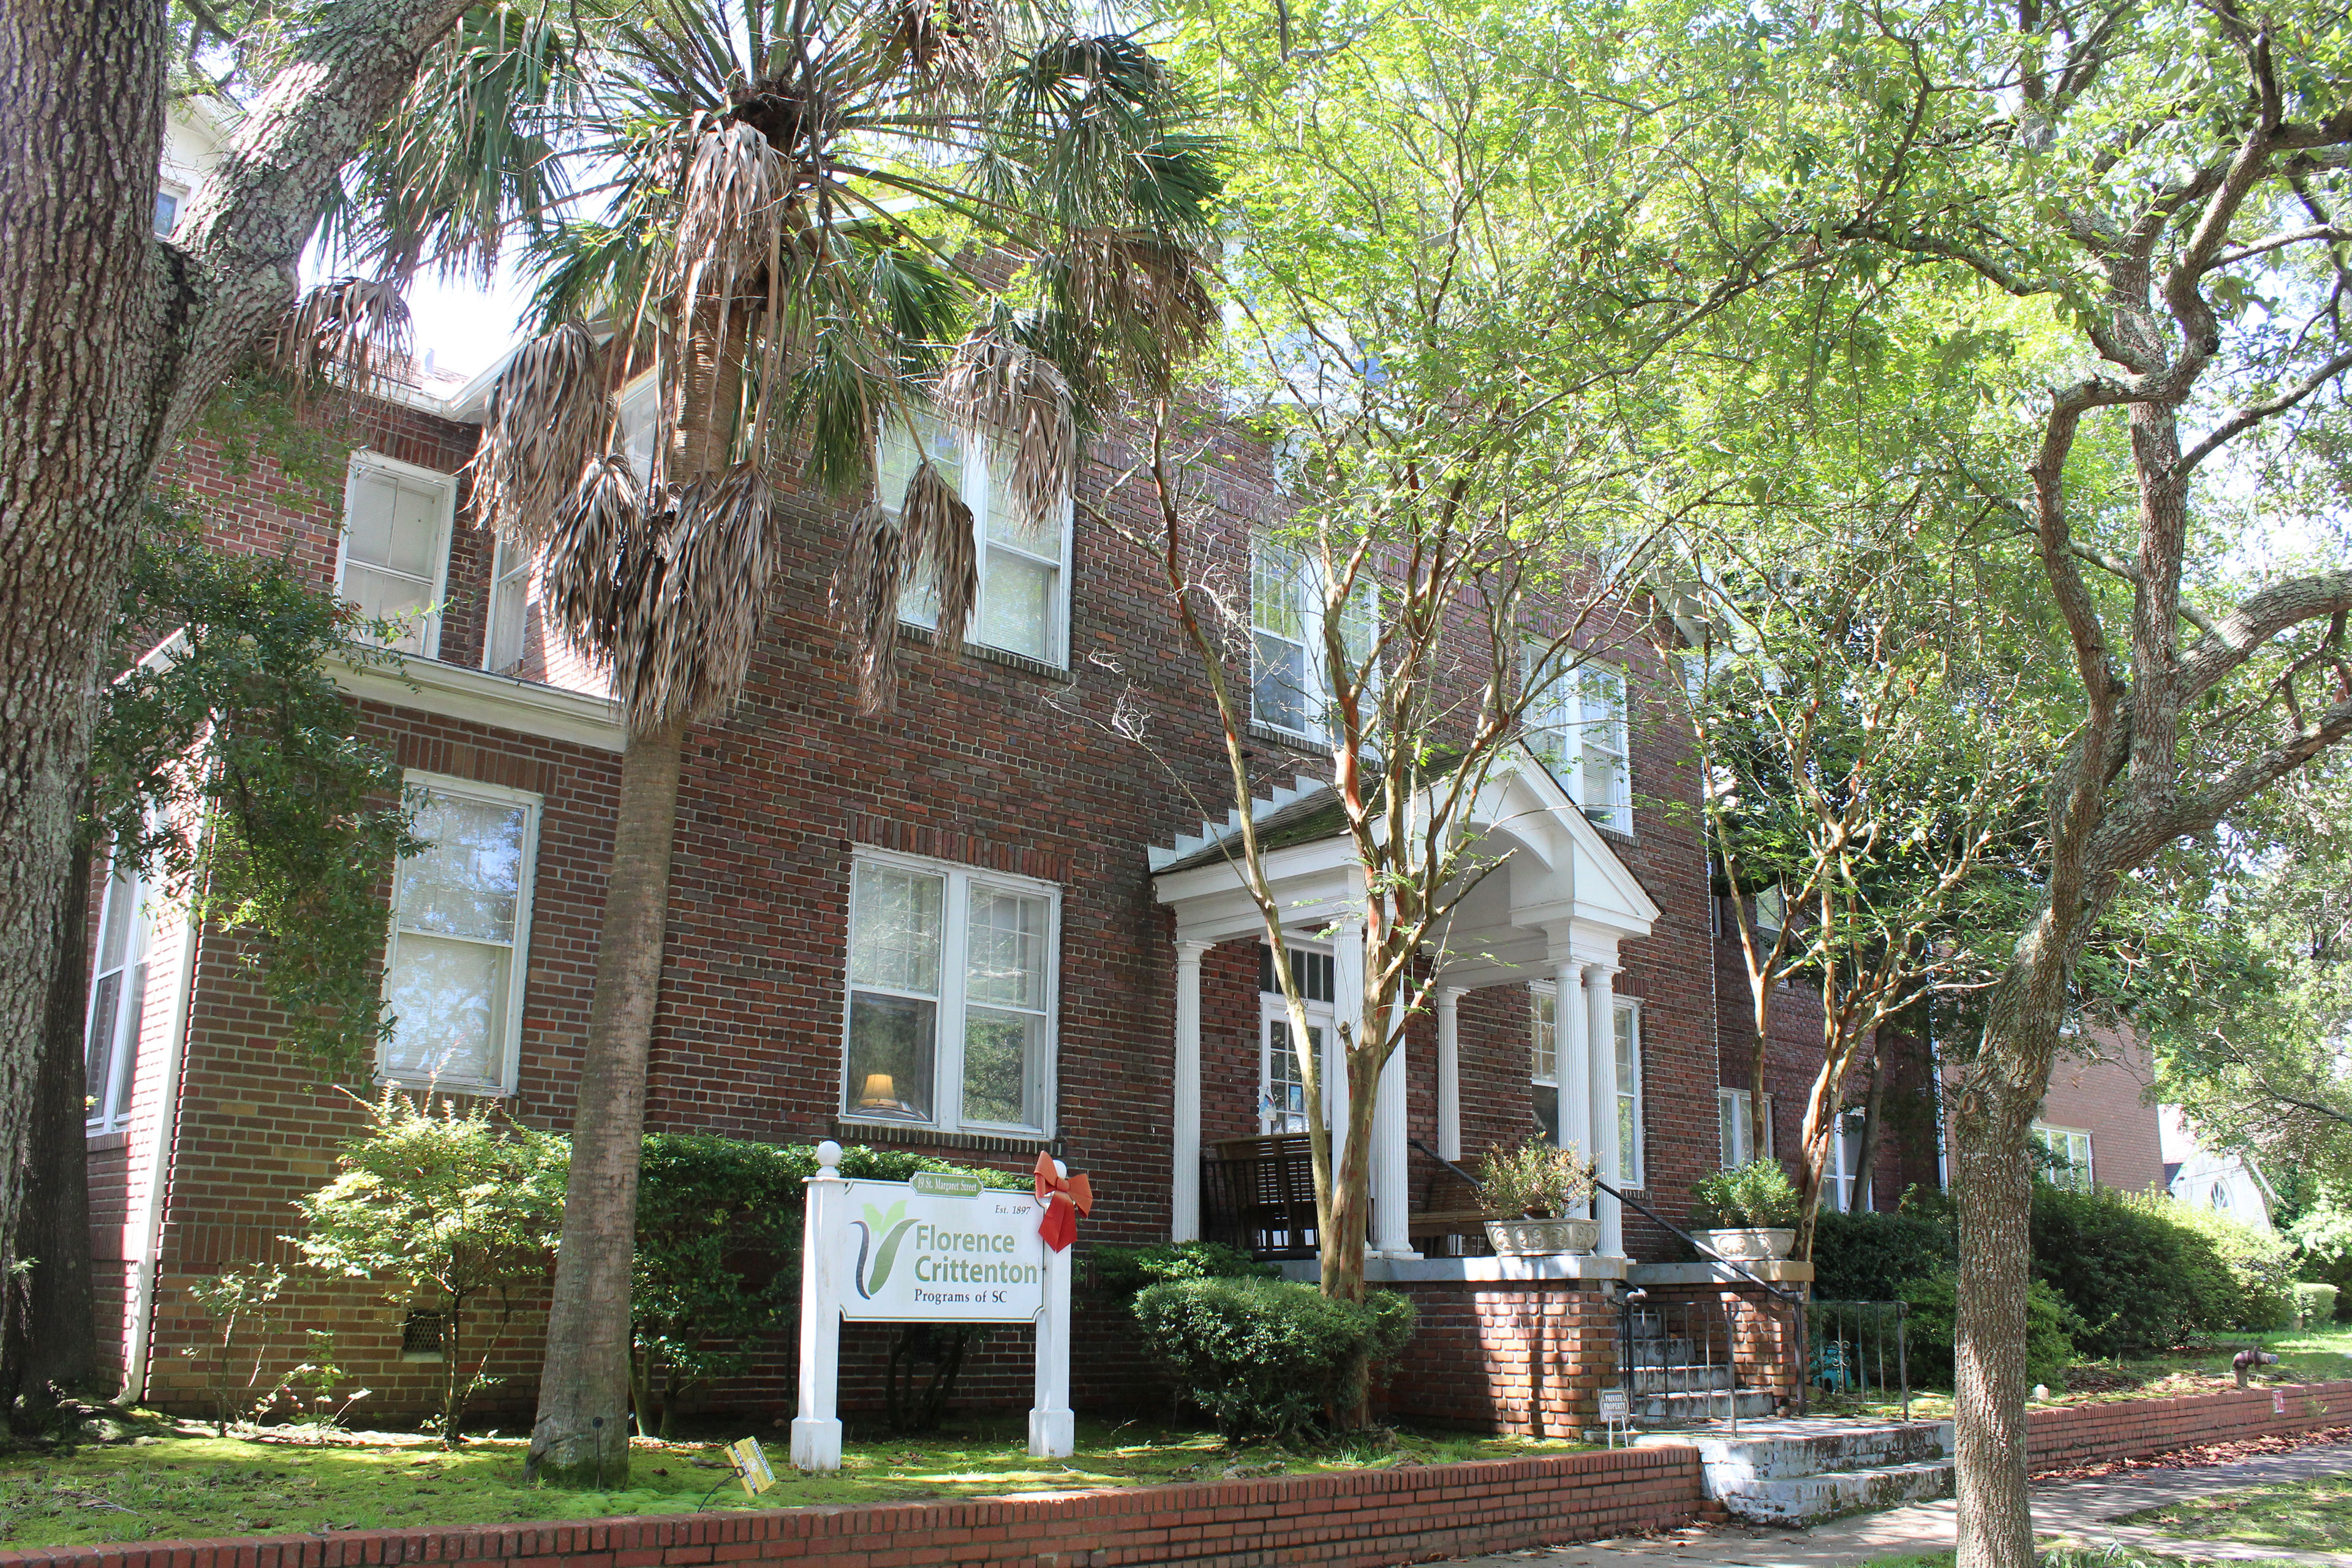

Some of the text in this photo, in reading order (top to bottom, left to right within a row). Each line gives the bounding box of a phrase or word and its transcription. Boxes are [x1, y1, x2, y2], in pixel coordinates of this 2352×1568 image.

[918, 1177, 924, 1188] 19
[935, 1178, 959, 1192] Margaret
[960, 1180, 977, 1192] Street
[995, 1205, 1031, 1215] Est. 1897
[916, 1224, 1015, 1253] Florence
[914, 1255, 1037, 1284] Crittenton
[914, 1289, 1008, 1305] Programs of SC
[751, 1440, 774, 1481] MosquitoNix
